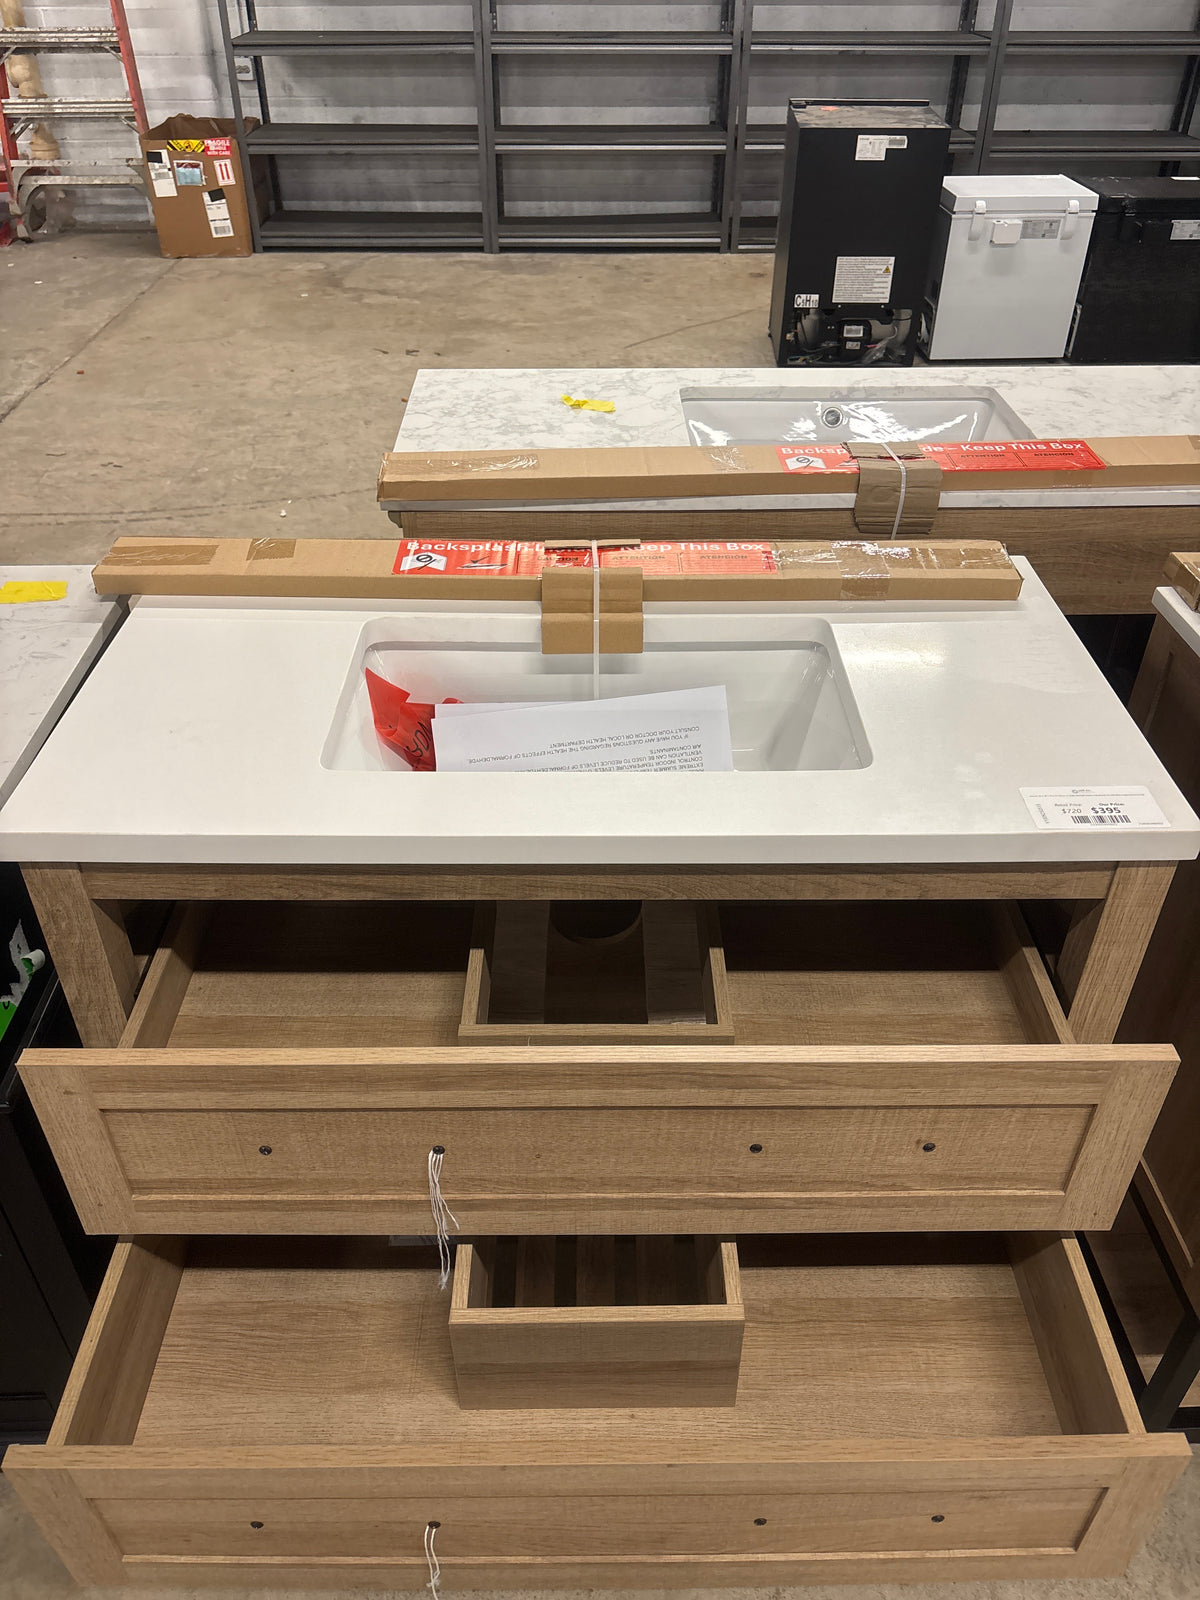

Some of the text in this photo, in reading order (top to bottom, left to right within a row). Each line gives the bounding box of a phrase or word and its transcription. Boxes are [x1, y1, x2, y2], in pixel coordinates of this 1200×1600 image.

[781, 447, 846, 455] Backsp
[960, 444, 1006, 452] Keep
[1007, 442, 1047, 450] This
[407, 542, 528, 553] Backsplash
[678, 542, 720, 551] This
[726, 542, 764, 551] Box
[580, 743, 611, 751] REGARDING
